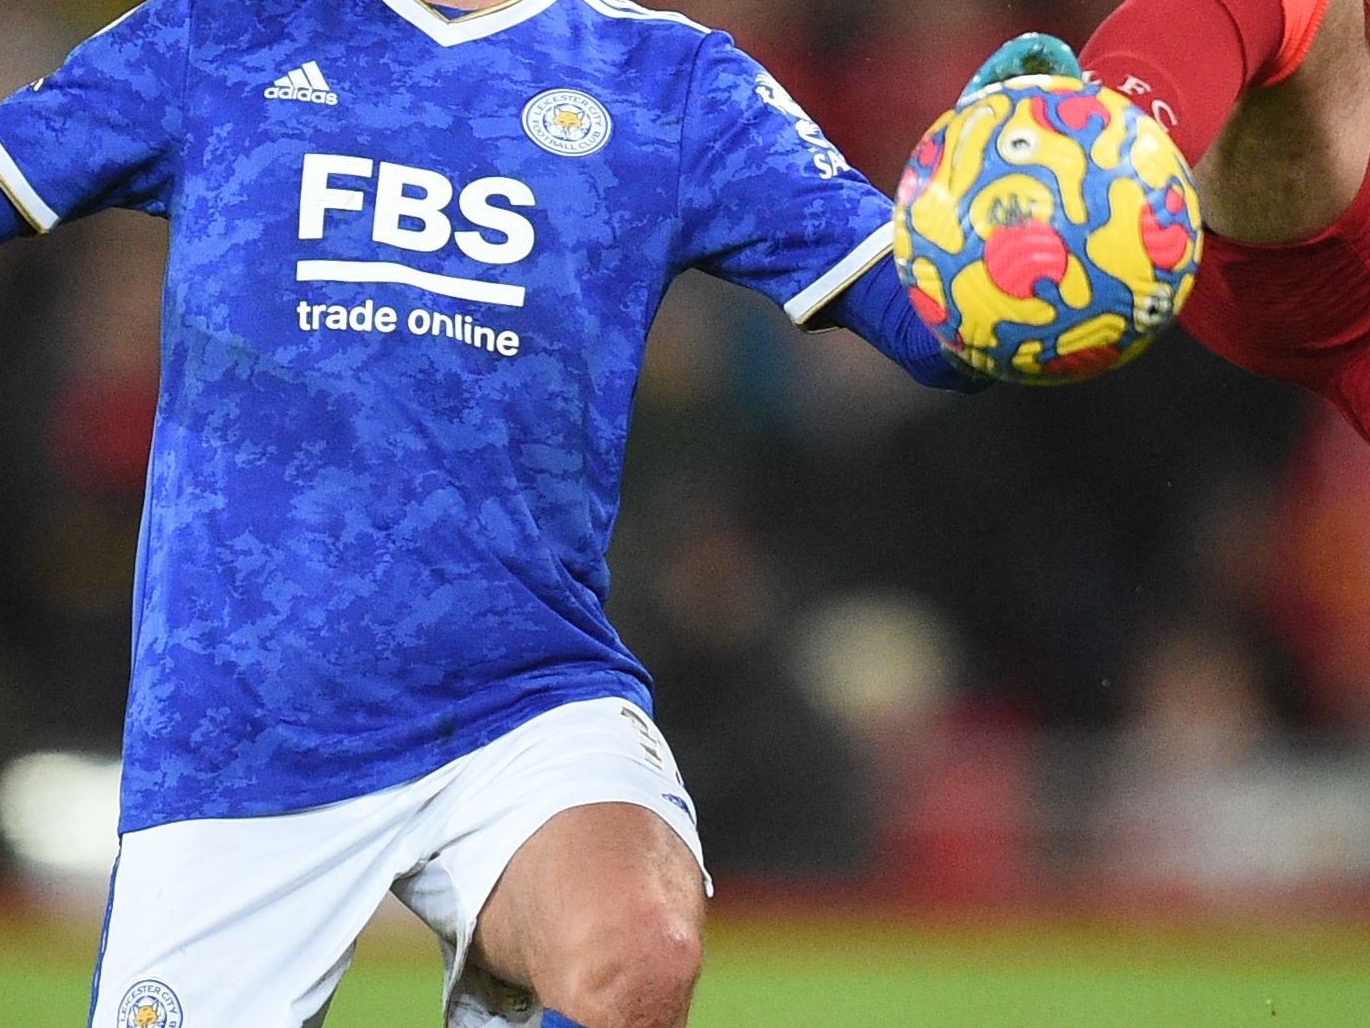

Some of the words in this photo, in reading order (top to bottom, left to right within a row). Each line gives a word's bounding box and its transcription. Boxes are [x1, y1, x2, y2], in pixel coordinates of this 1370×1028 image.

[263, 85, 339, 106] adidas
[297, 153, 536, 265] FBS
[296, 299, 398, 333] trade
[407, 307, 520, 357] online
